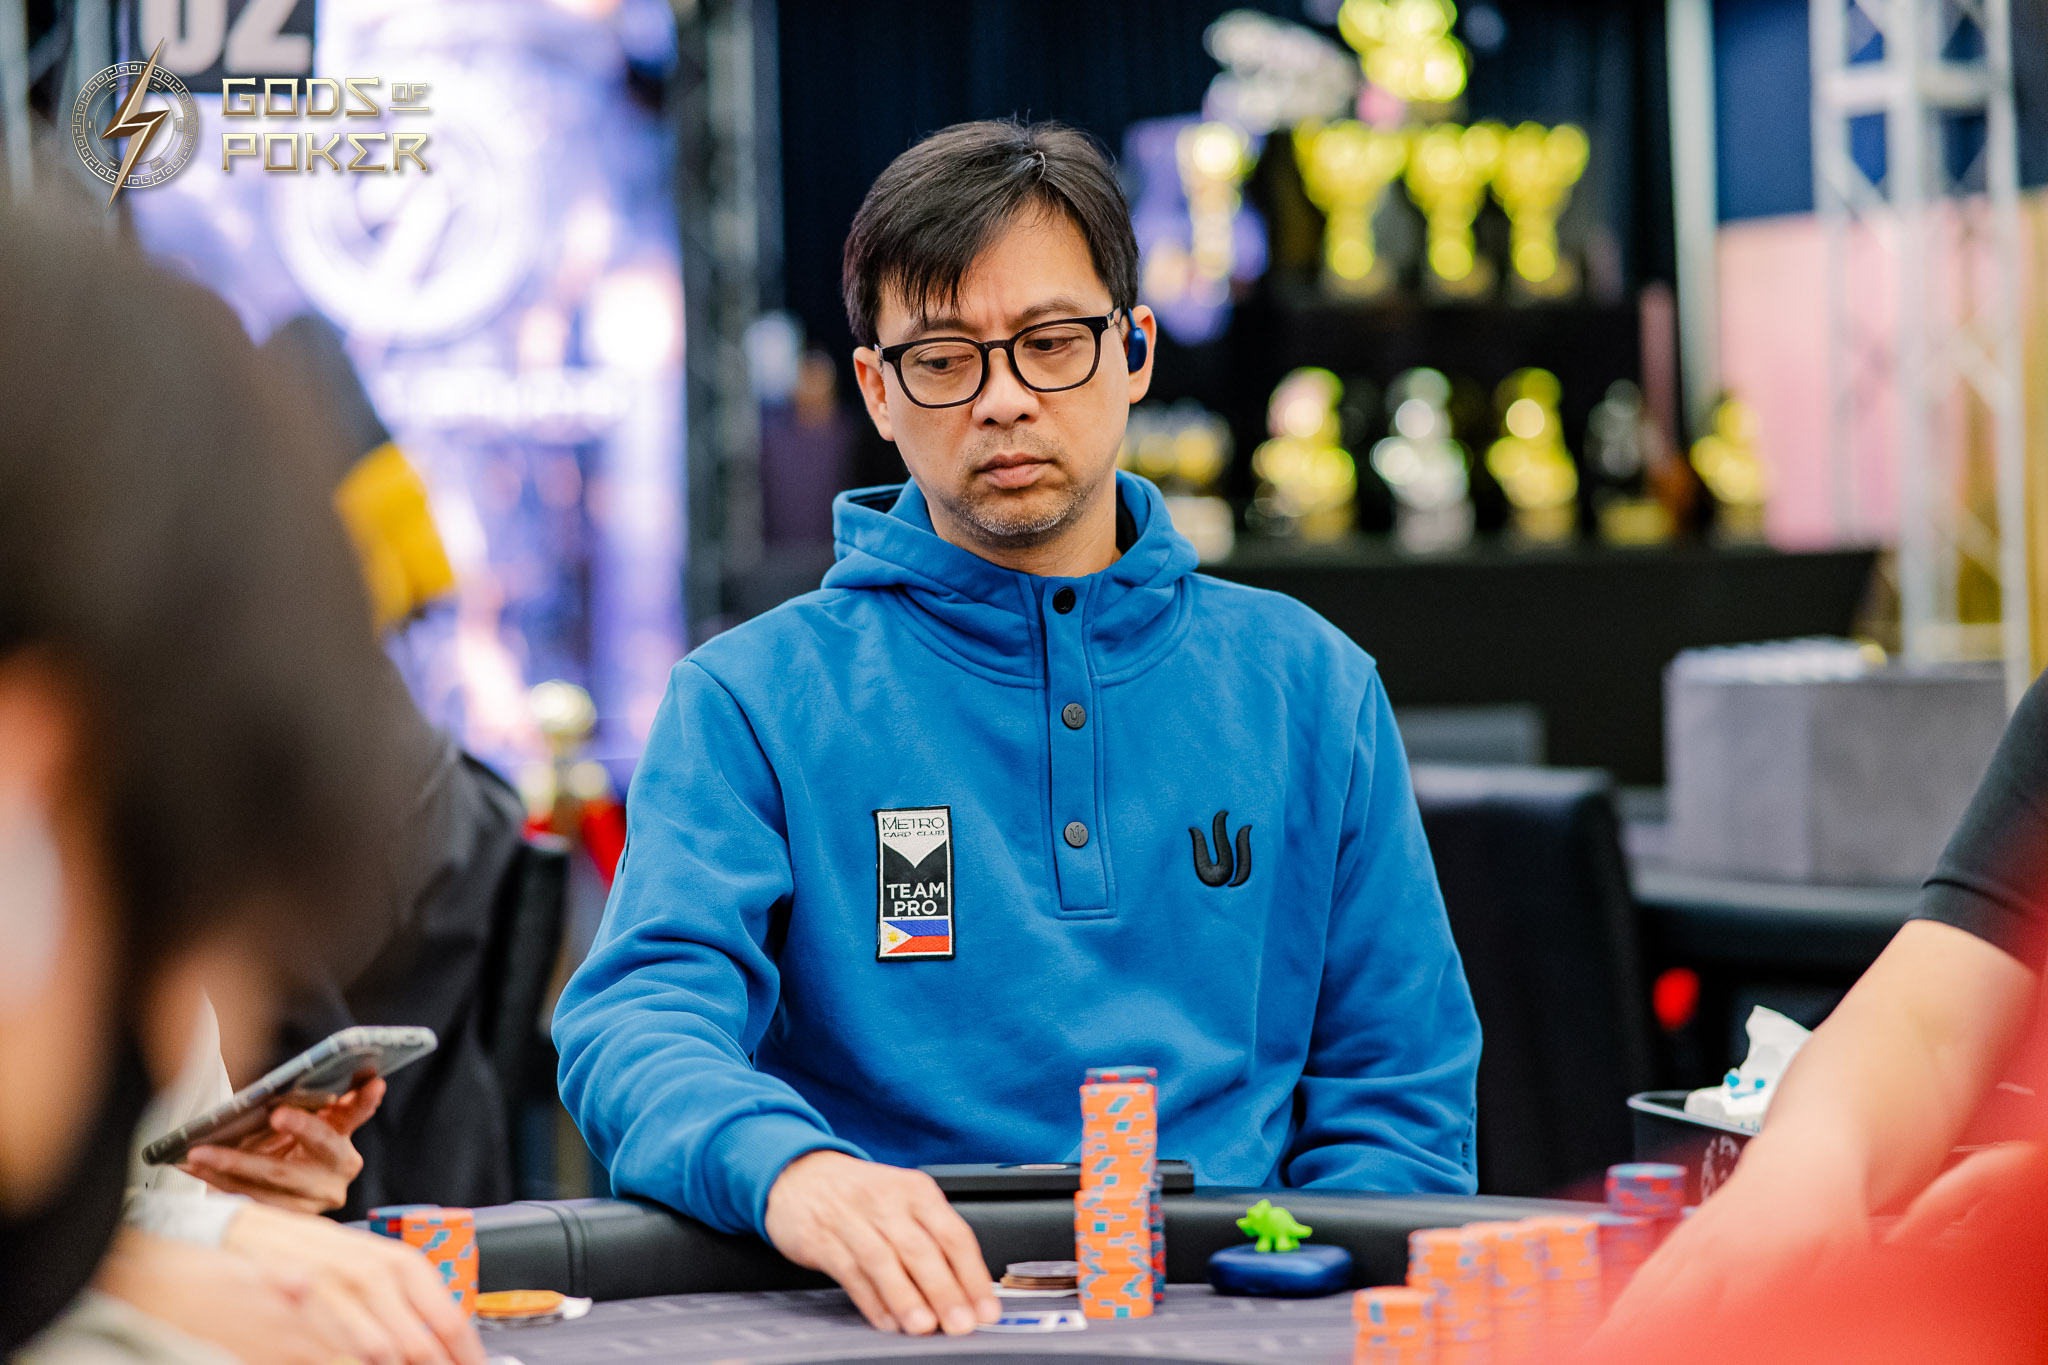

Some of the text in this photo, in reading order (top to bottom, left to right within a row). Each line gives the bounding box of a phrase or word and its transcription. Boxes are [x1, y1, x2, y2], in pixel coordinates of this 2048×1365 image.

[882, 816, 945, 830] METRO
[886, 882, 945, 899] TEAM
[894, 900, 938, 916] PRO
